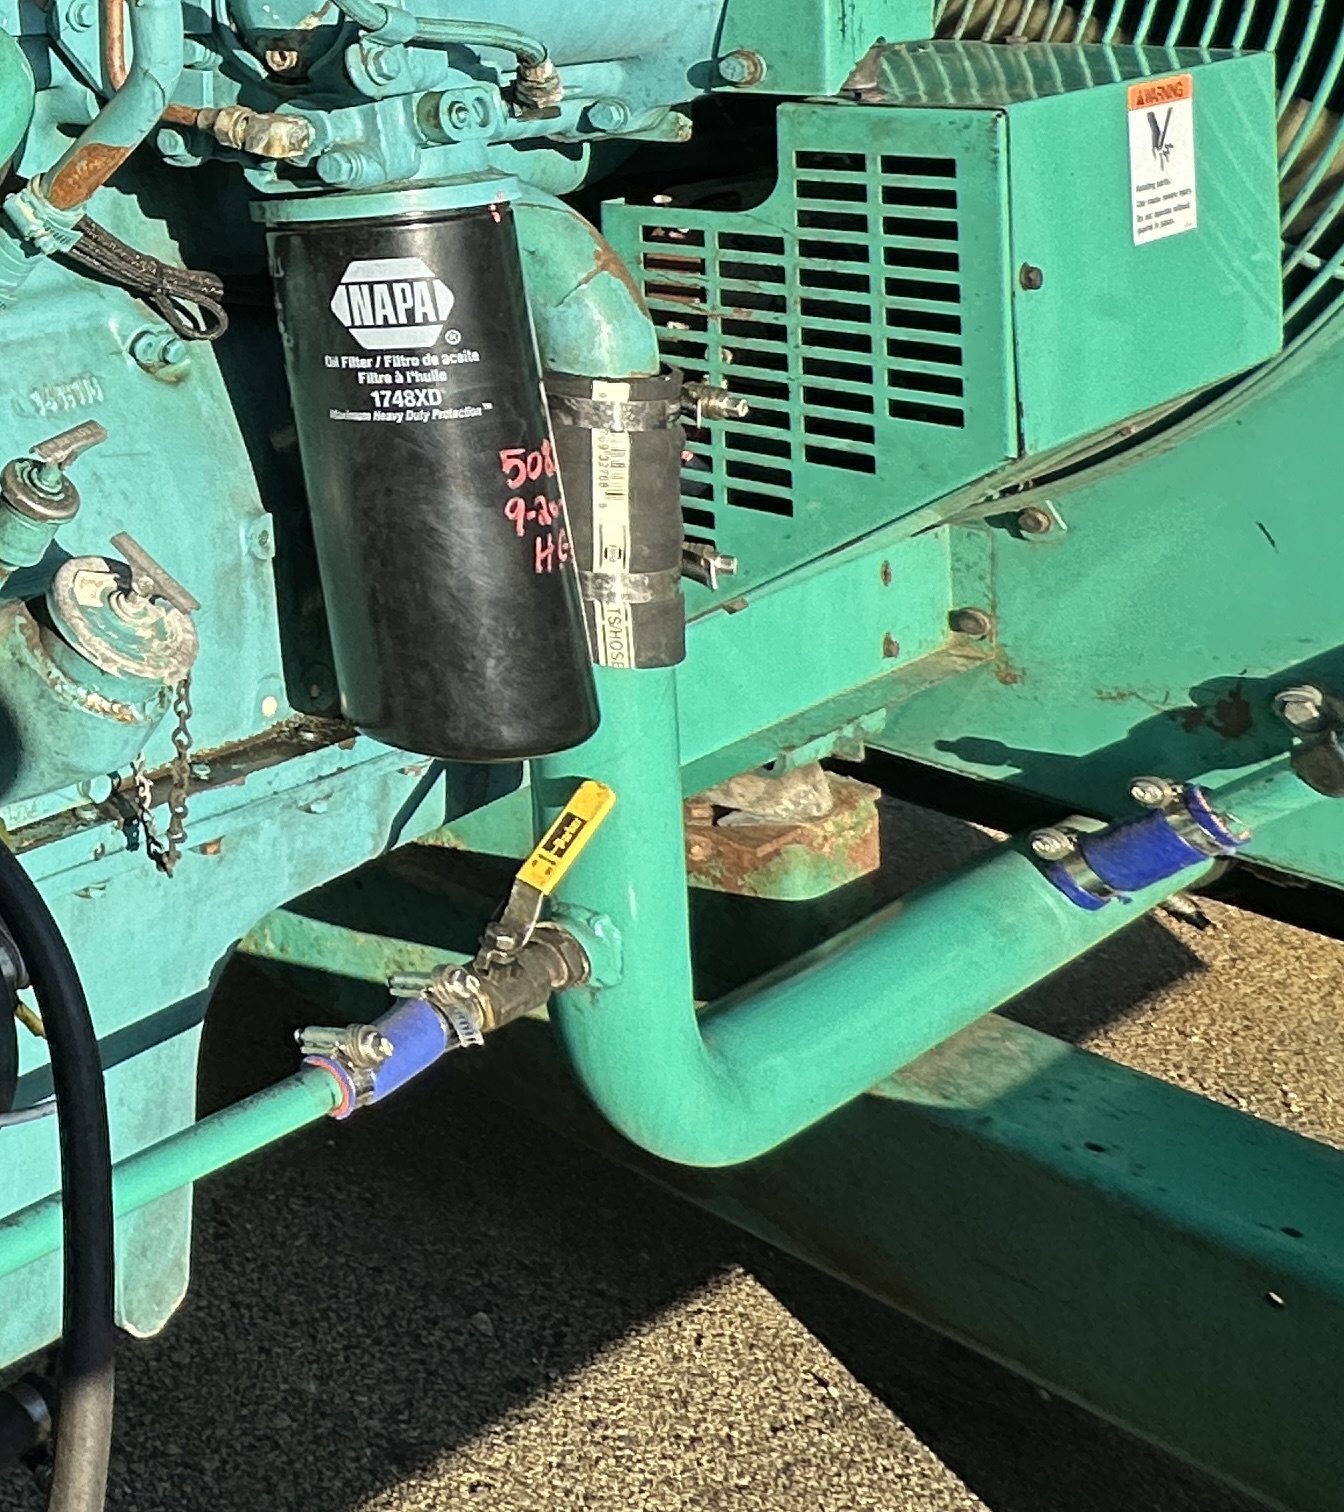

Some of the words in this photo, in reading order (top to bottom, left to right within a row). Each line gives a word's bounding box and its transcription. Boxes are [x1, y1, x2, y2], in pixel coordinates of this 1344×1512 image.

[348, 281, 438, 326] NAPA
[340, 355, 373, 369] Filter
[384, 354, 420, 368] Filtro
[422, 353, 440, 367] de
[441, 349, 480, 365] aceite
[357, 370, 393, 384] Filtre
[370, 388, 443, 408] 1748XD
[372, 409, 404, 424] Heavy
[405, 409, 430, 423] Duty
